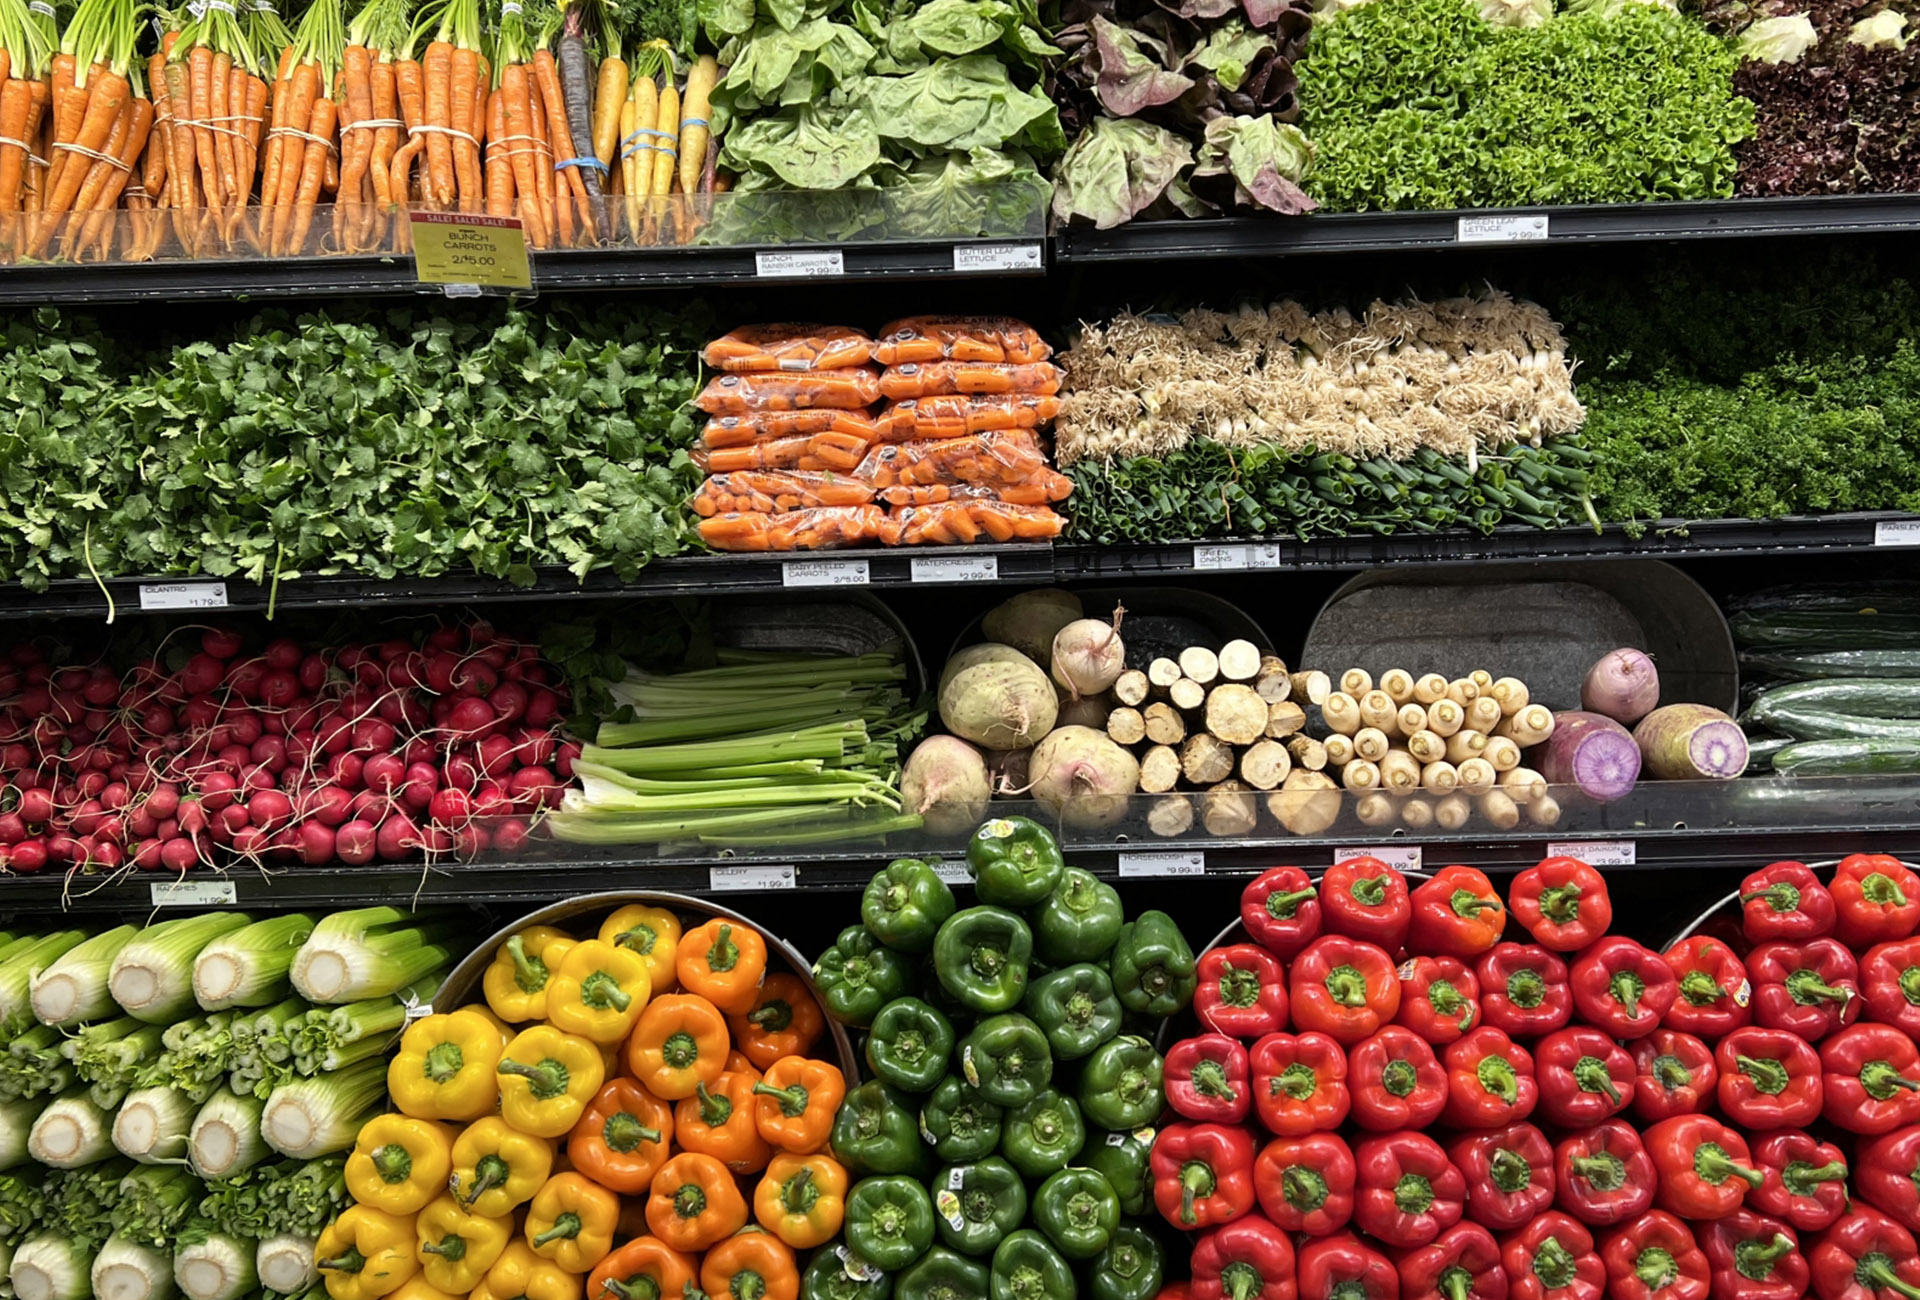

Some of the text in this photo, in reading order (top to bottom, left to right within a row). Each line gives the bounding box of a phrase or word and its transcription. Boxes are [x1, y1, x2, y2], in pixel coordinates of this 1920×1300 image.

[427, 214, 507, 227] SALE! SALE! SALE!
[1464, 225, 1502, 233] LETTUCE
[449, 232, 489, 242] BUNCH
[443, 241, 497, 252] CARROTS
[761, 255, 792, 263] BUNCH
[960, 255, 997, 263] LETTUCE
[795, 260, 828, 268] CARROTS
[715, 868, 748, 876] CELERY
